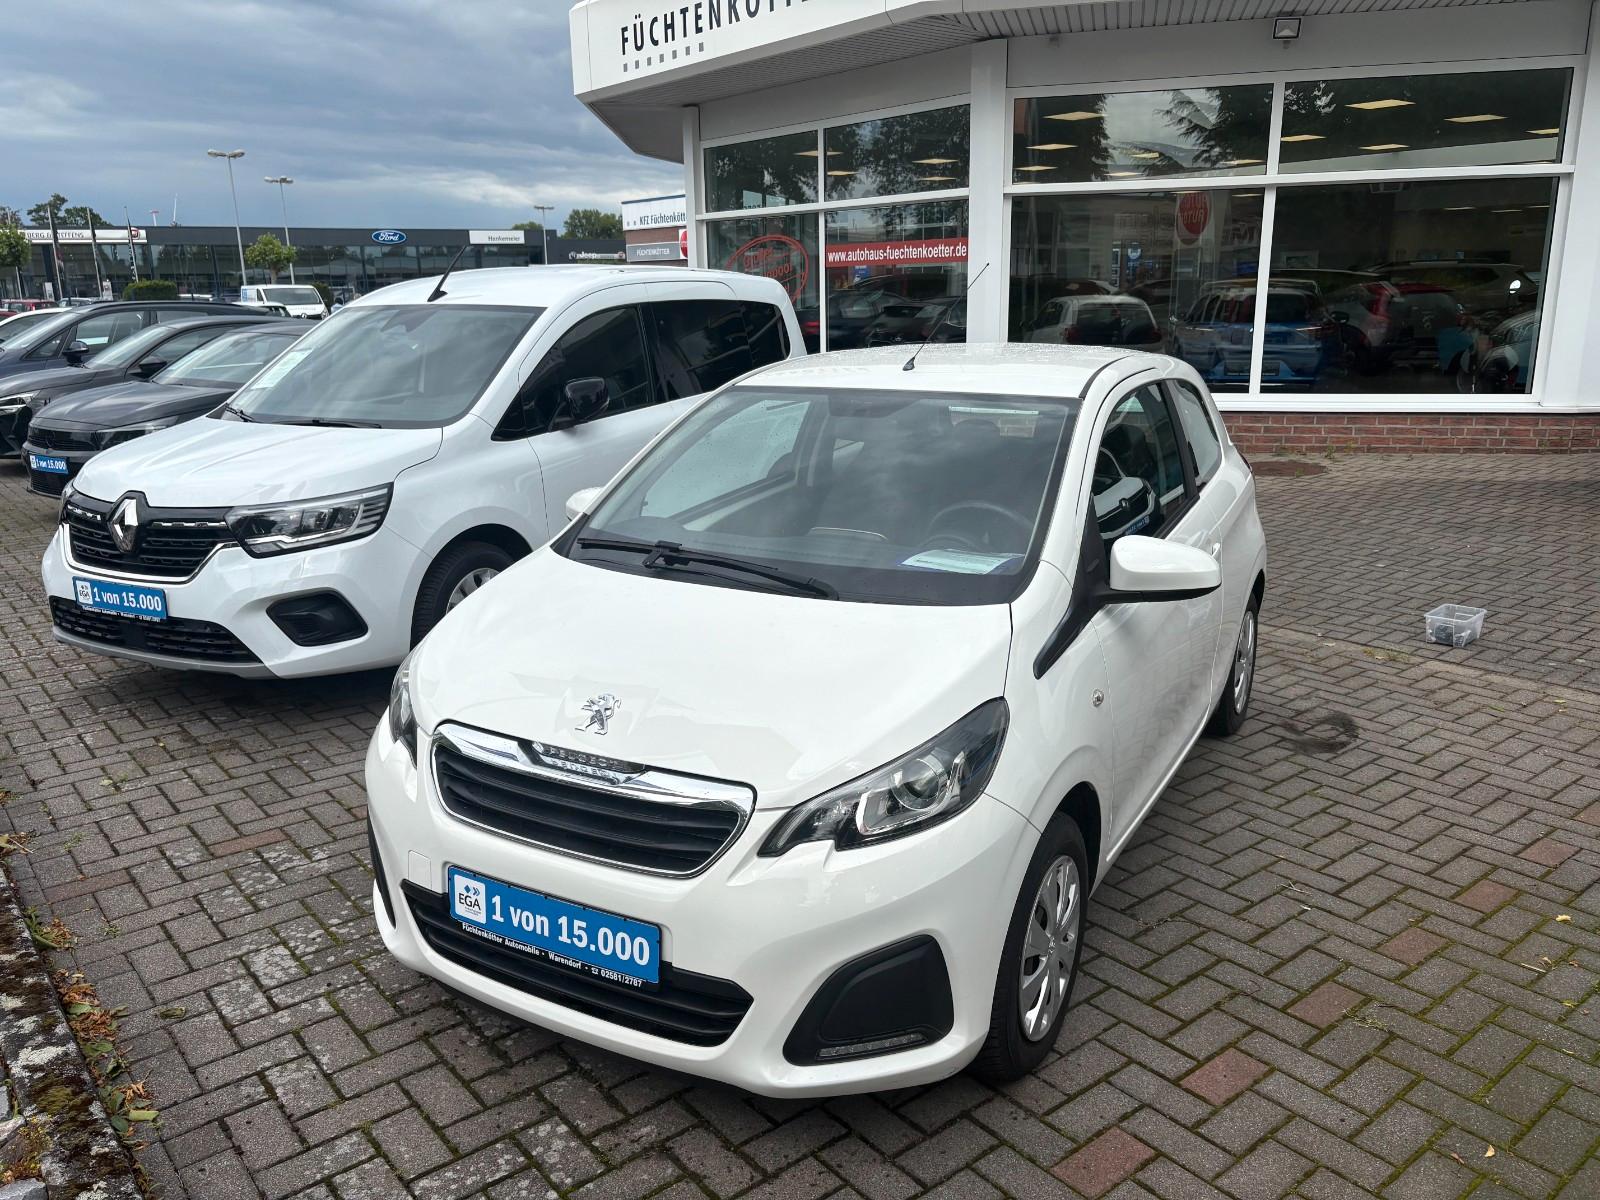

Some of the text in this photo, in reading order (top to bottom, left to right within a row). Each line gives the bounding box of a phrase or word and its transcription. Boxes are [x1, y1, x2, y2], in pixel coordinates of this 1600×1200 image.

[640, 211, 687, 226] KFZ Füchtenkött
[378, 231, 400, 242] Ford
[827, 242, 967, 263] www.autohaus-fuechtenkoetter.de
[93, 586, 162, 611] 1 von 15.000
[458, 892, 481, 912] EGA
[491, 894, 650, 967] 1 von 15.000
[461, 921, 504, 944] Füchtenkötter
[504, 938, 541, 956] Automobile
[548, 950, 582, 970] Warendorf
